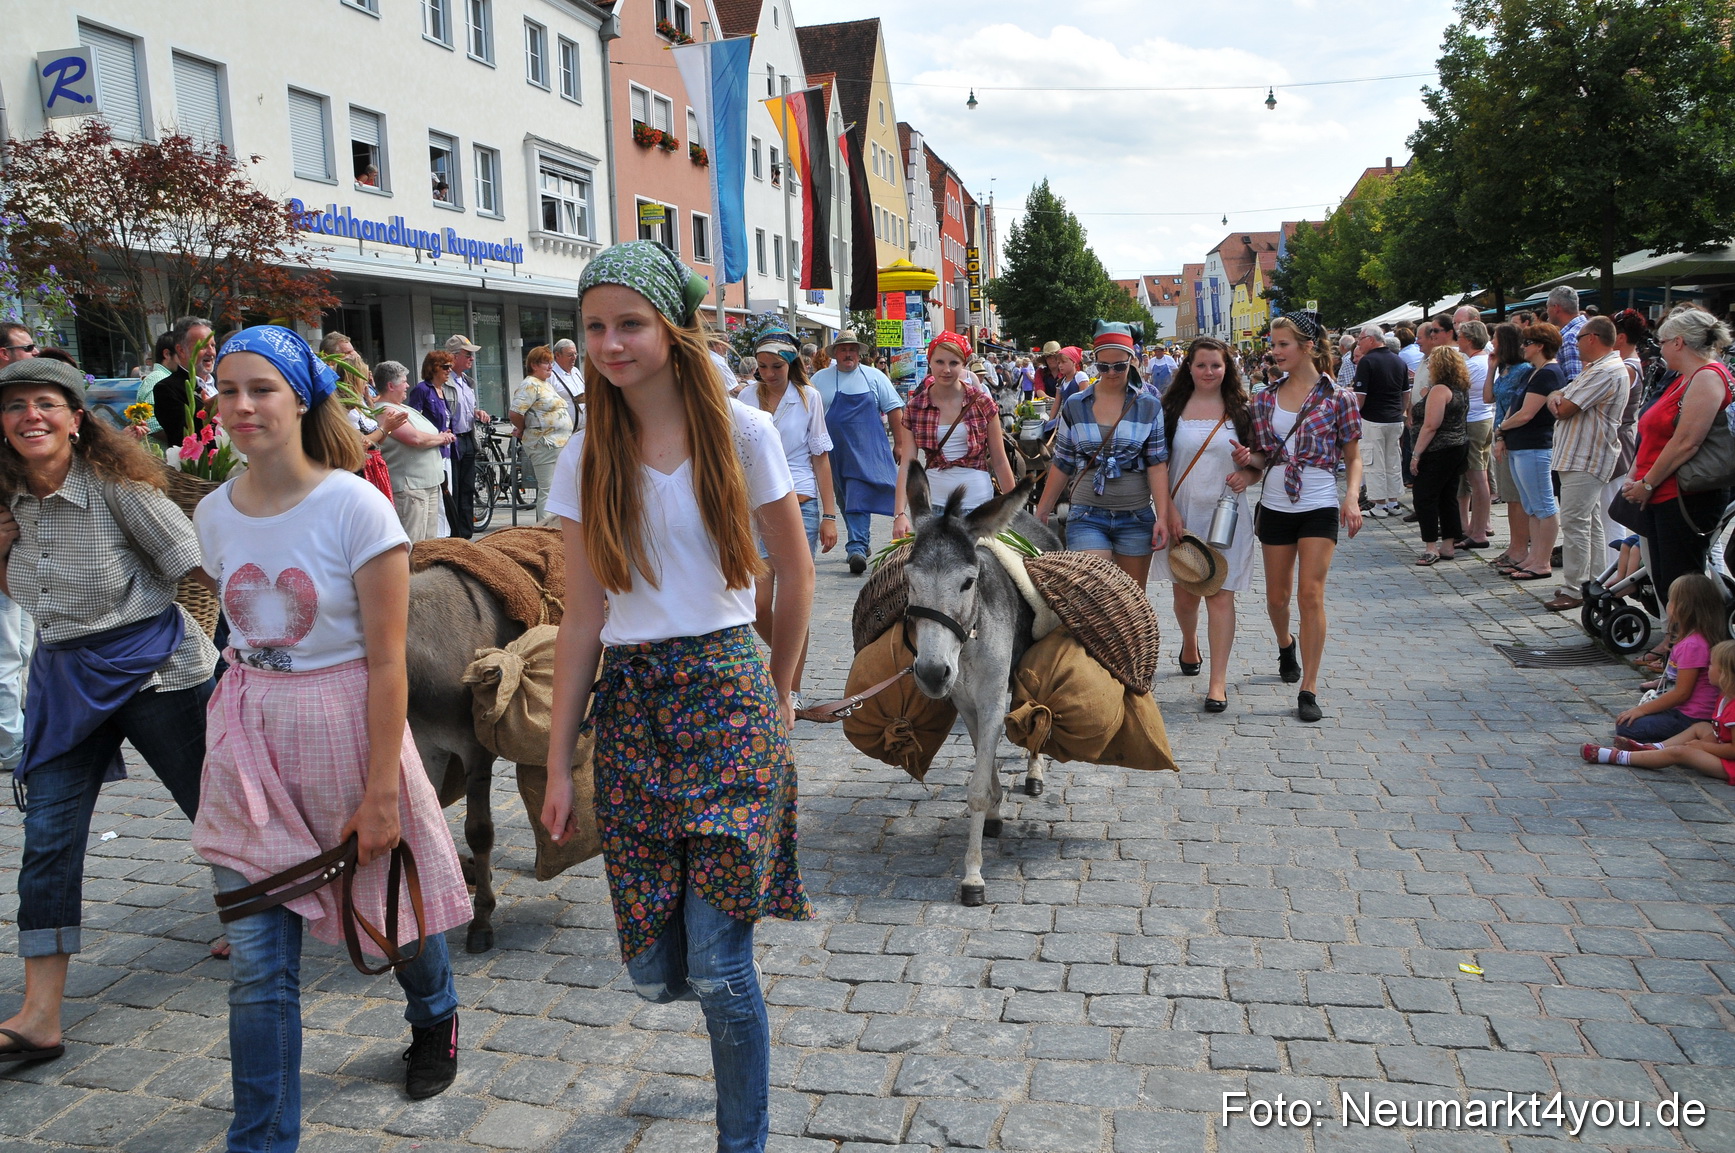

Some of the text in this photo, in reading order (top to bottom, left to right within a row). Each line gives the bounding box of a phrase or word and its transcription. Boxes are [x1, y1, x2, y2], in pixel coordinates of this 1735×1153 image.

[290, 198, 523, 265] Buchhandlung Rupprecht
[967, 248, 980, 311] HOTEL
